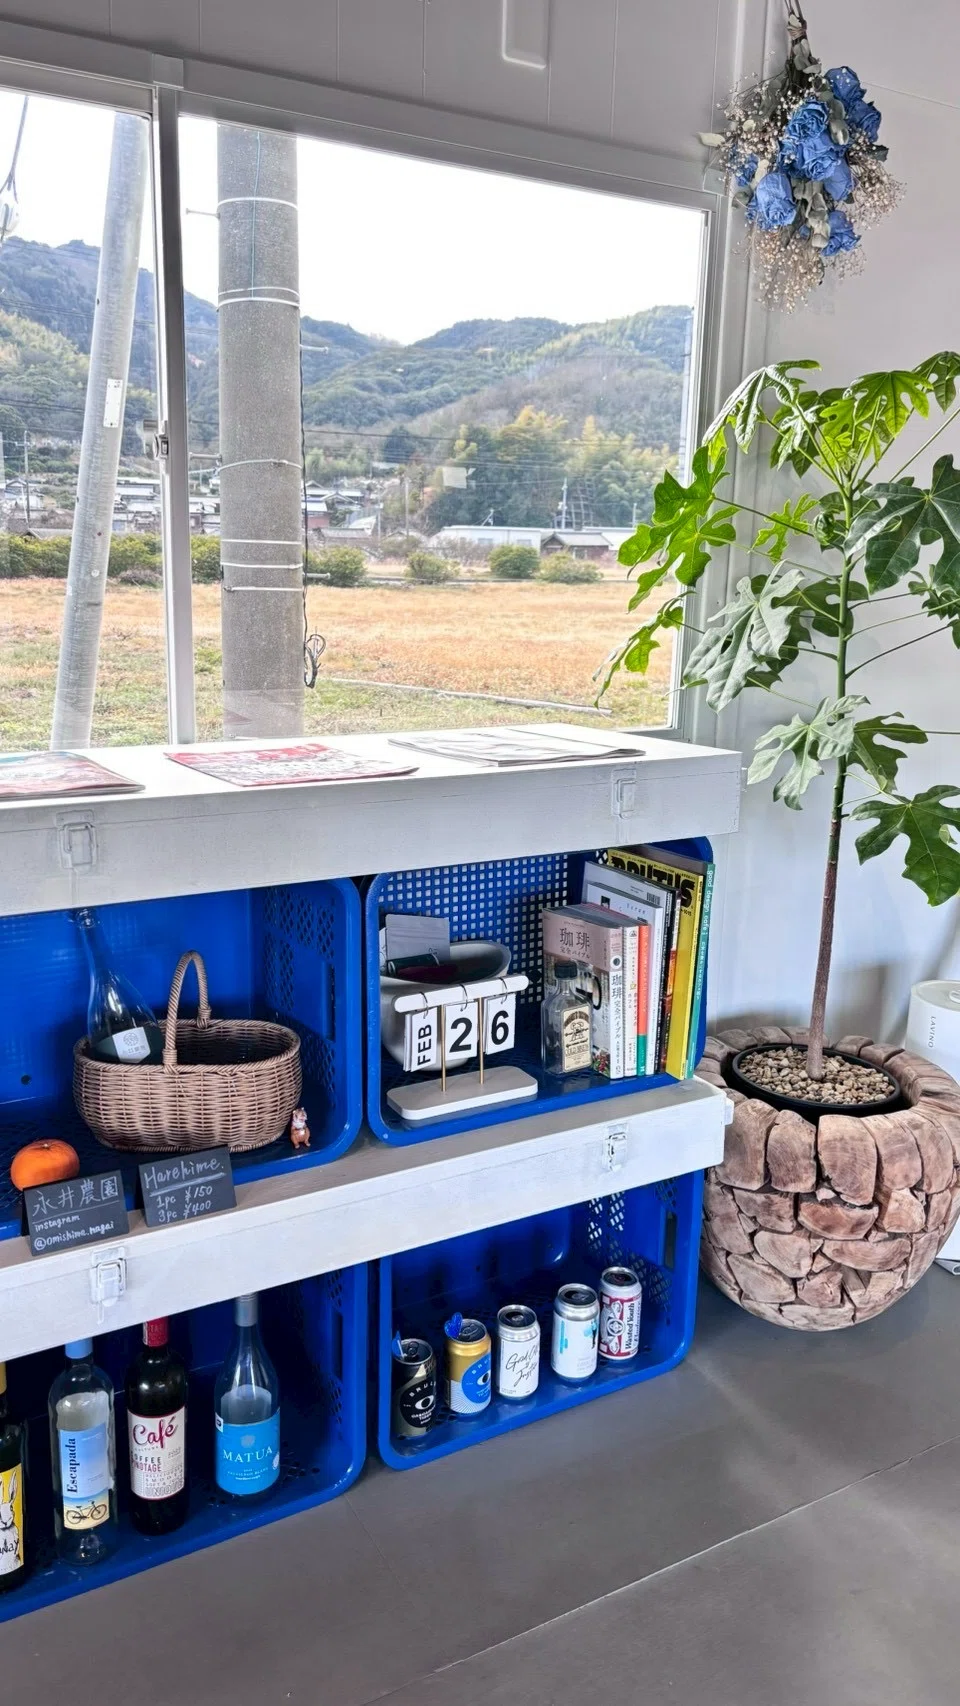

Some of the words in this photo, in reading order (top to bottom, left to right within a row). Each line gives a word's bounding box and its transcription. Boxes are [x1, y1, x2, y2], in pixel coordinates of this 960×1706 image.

[559, 928, 590, 951] 珈琲
[417, 1024, 432, 1066] FEB
[449, 1017, 472, 1053] 2
[491, 1010, 509, 1045] 6
[32, 1175, 118, 1217] 永井農園
[184, 1186, 213, 1202] ¥150
[158, 1208, 177, 1223] 3pc
[183, 1200, 212, 1219] ¥400
[626, 1302, 635, 1323] Youth
[624, 1322, 634, 1349] Wasted
[133, 1416, 178, 1448] Café
[65, 1438, 80, 1493] Escapada
[223, 1446, 273, 1463] MATUA
